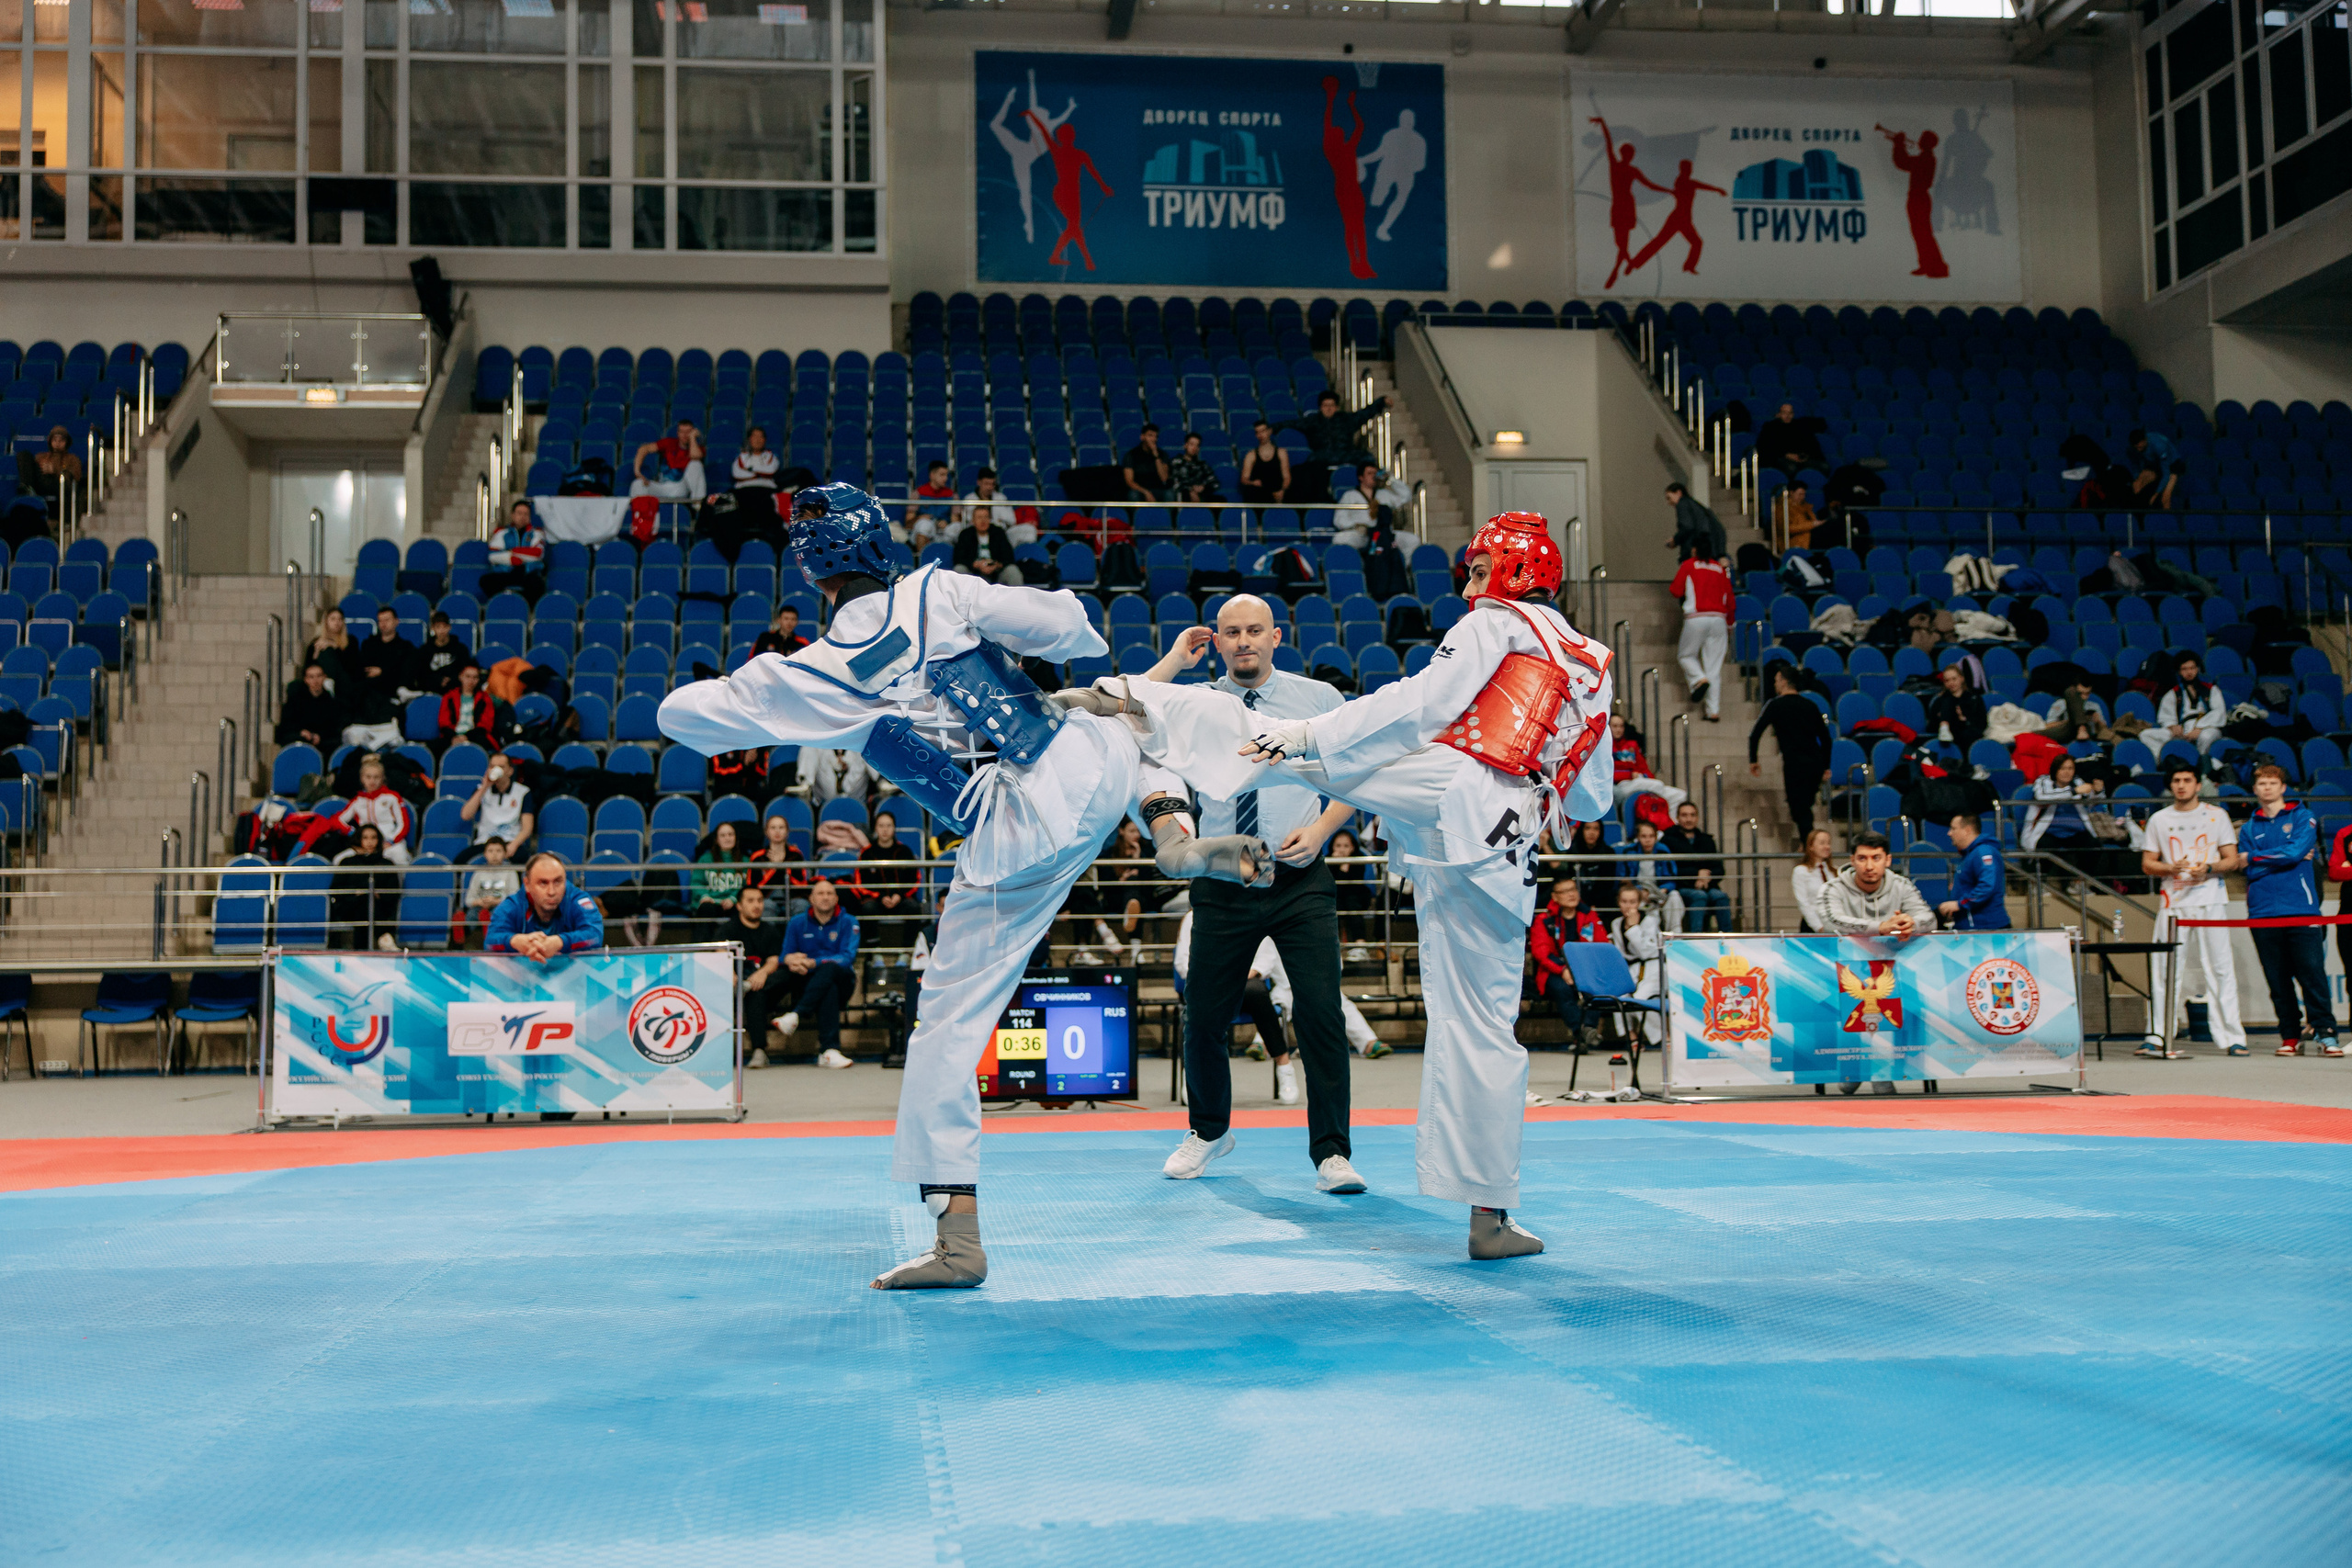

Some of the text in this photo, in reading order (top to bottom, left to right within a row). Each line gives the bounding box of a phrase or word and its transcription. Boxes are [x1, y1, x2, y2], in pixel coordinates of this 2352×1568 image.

[1143, 109, 1282, 127] ДВОРЕЦ СПОРТА
[1731, 127, 1861, 141] ДВОРЕЦ СПОРТА
[1143, 190, 1285, 230] ТРИУМФ
[1732, 207, 1867, 243] ТРИУМФ
[1033, 993, 1091, 1001] ОВЧИННИКОВ
[1103, 1008, 1126, 1017] RUS
[1012, 1018, 1033, 1029] 114
[1003, 1036, 1041, 1052] 0:36
[1062, 1025, 1086, 1060] 0
[1009, 1070, 1035, 1078] ROUND
[979, 1082, 988, 1092] 3
[1019, 1079, 1025, 1089] 1
[1057, 1081, 1065, 1091] 2
[1112, 1079, 1120, 1089] 2
